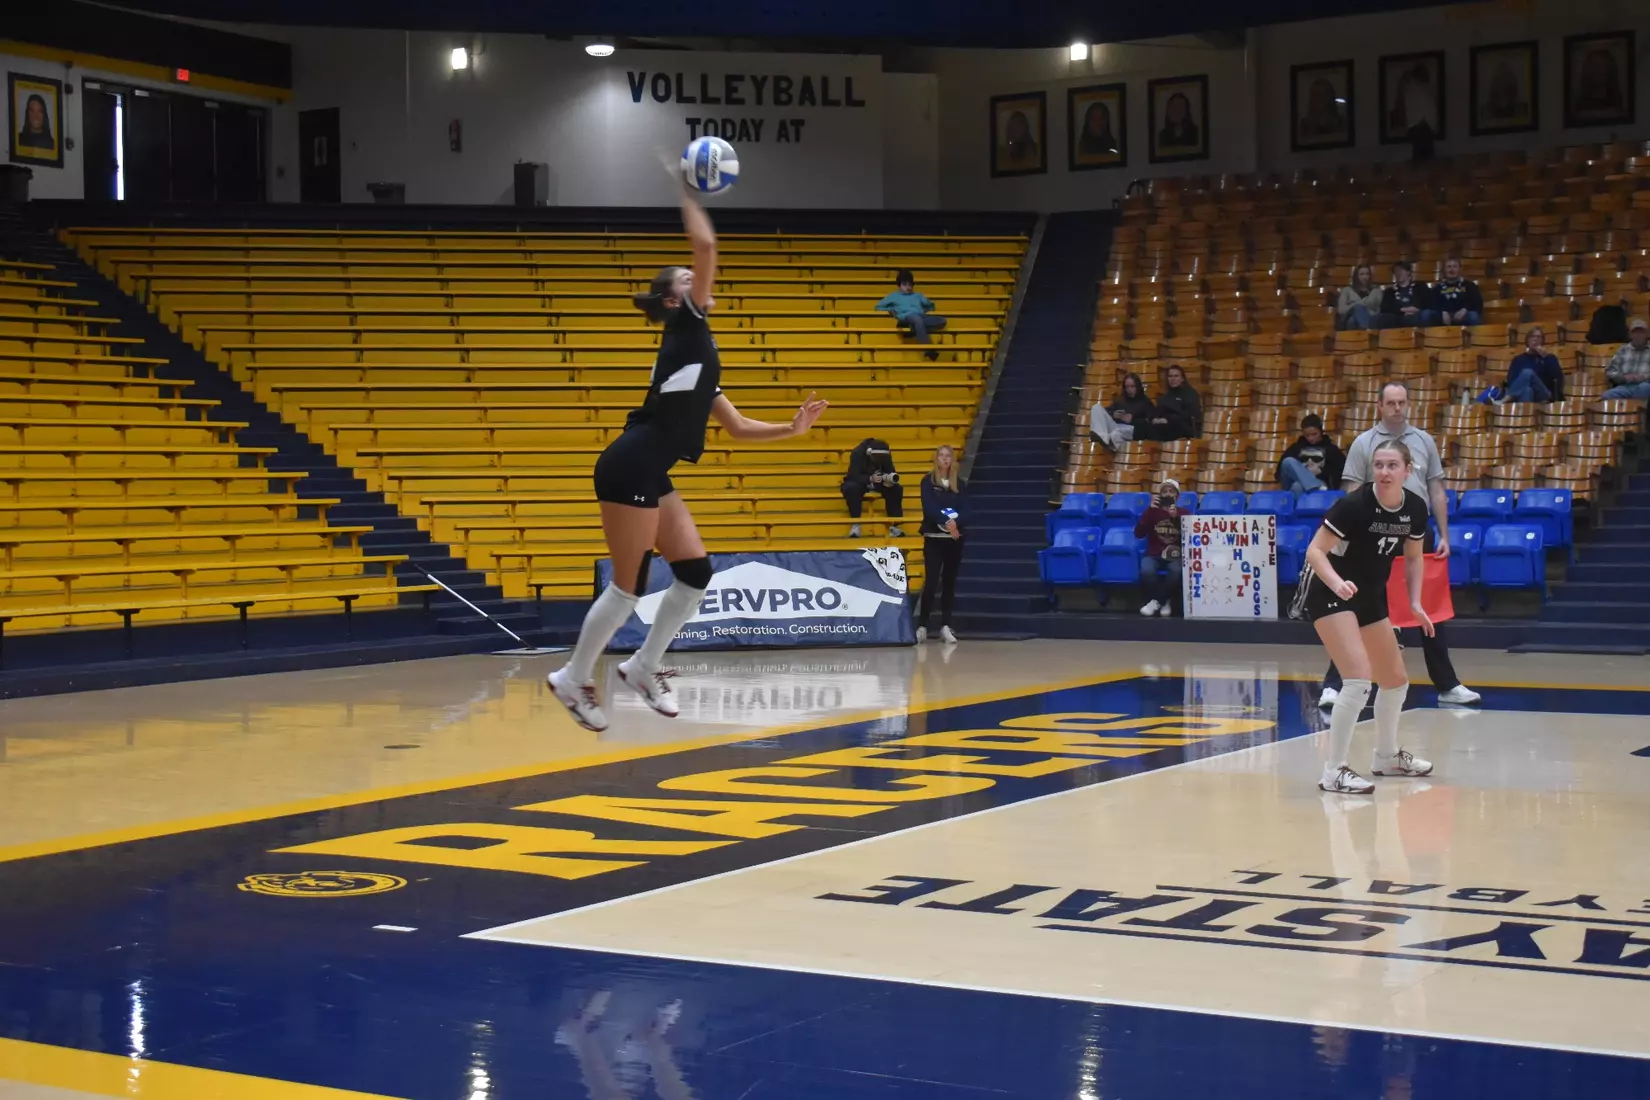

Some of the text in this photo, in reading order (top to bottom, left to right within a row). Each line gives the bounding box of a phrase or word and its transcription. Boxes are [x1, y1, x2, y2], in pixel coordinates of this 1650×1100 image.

[627, 71, 866, 108] VOLLEYBALL
[685, 117, 805, 143] TODAY AT
[1193, 517, 1247, 533] SALUKI
[1268, 516, 1276, 566] CUTE
[1377, 536, 1399, 556] 17
[1253, 566, 1261, 616] DOGS
[673, 622, 869, 641] aning. Restoration. Construction.
[267, 711, 1276, 881] RACERS
[813, 875, 1412, 942] STATE
